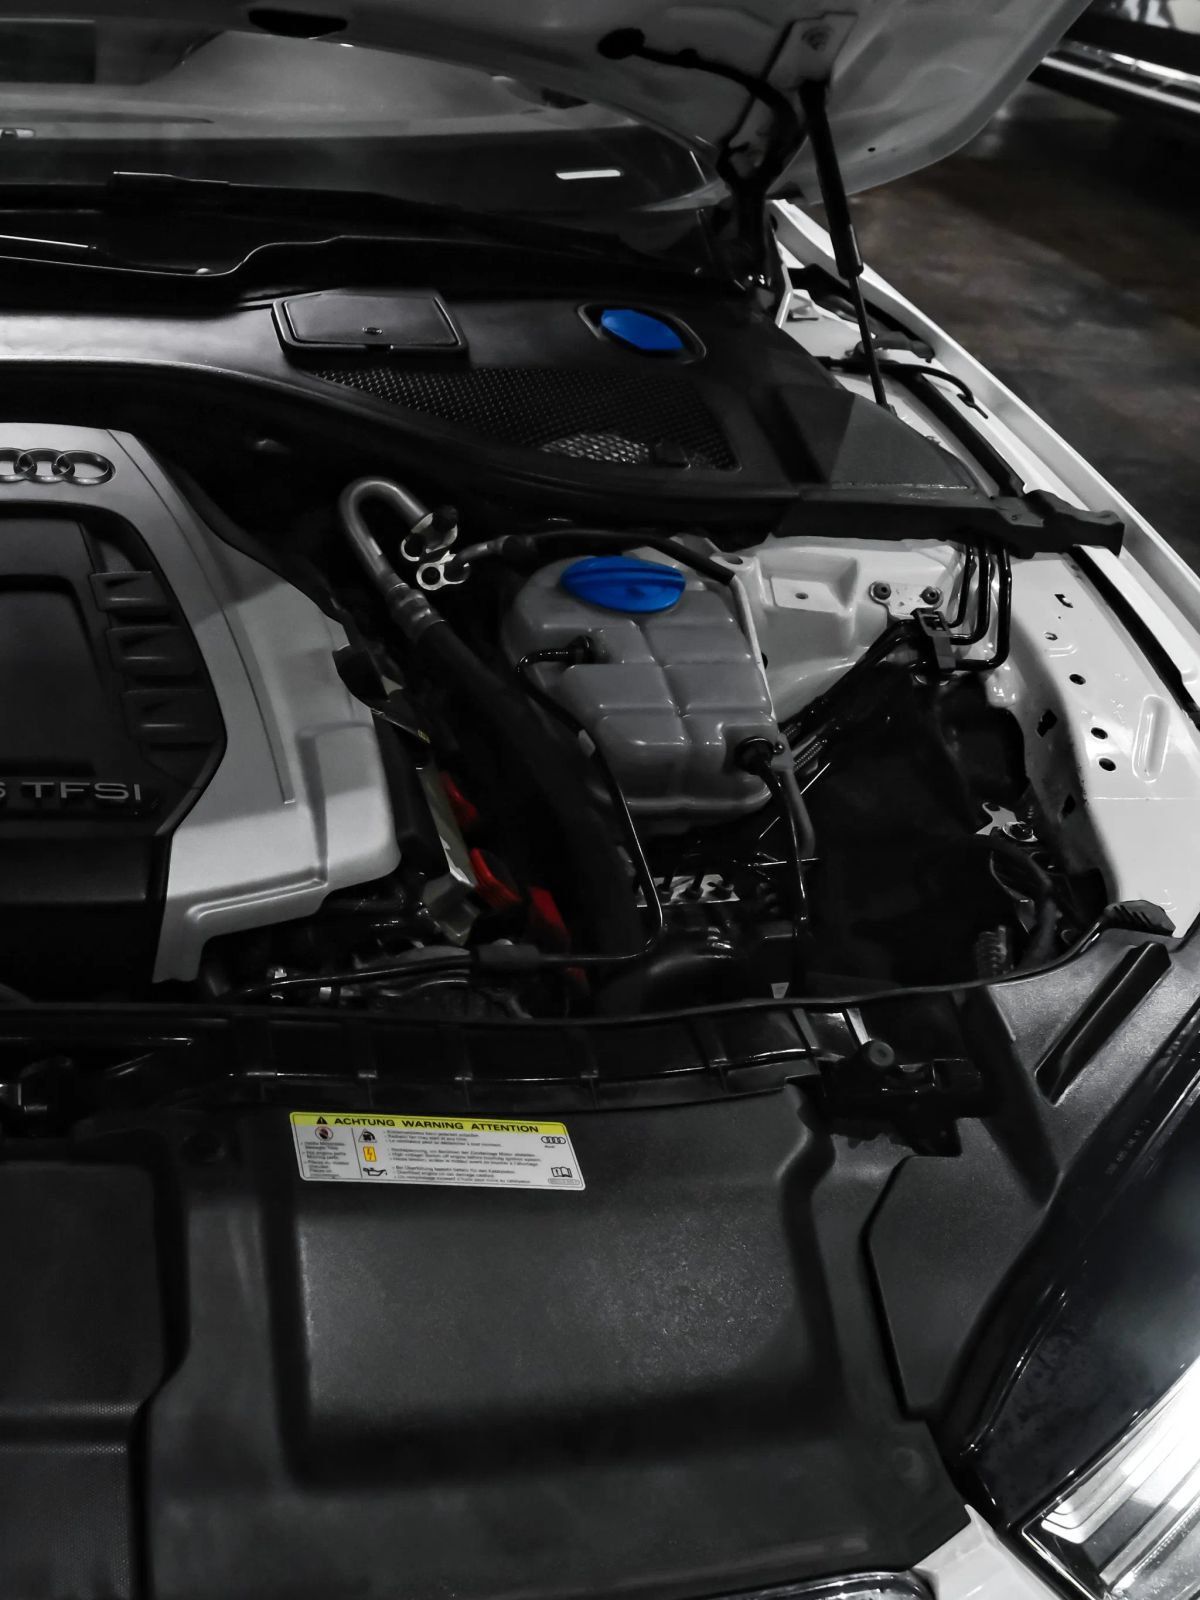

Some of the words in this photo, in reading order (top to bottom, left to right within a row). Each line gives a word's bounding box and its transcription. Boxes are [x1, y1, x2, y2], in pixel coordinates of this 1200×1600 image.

[21, 781, 141, 801] TFSI
[334, 1117, 396, 1127] ACHTUNG
[401, 1120, 464, 1130] WARNING
[471, 1123, 539, 1133] ATTENTION
